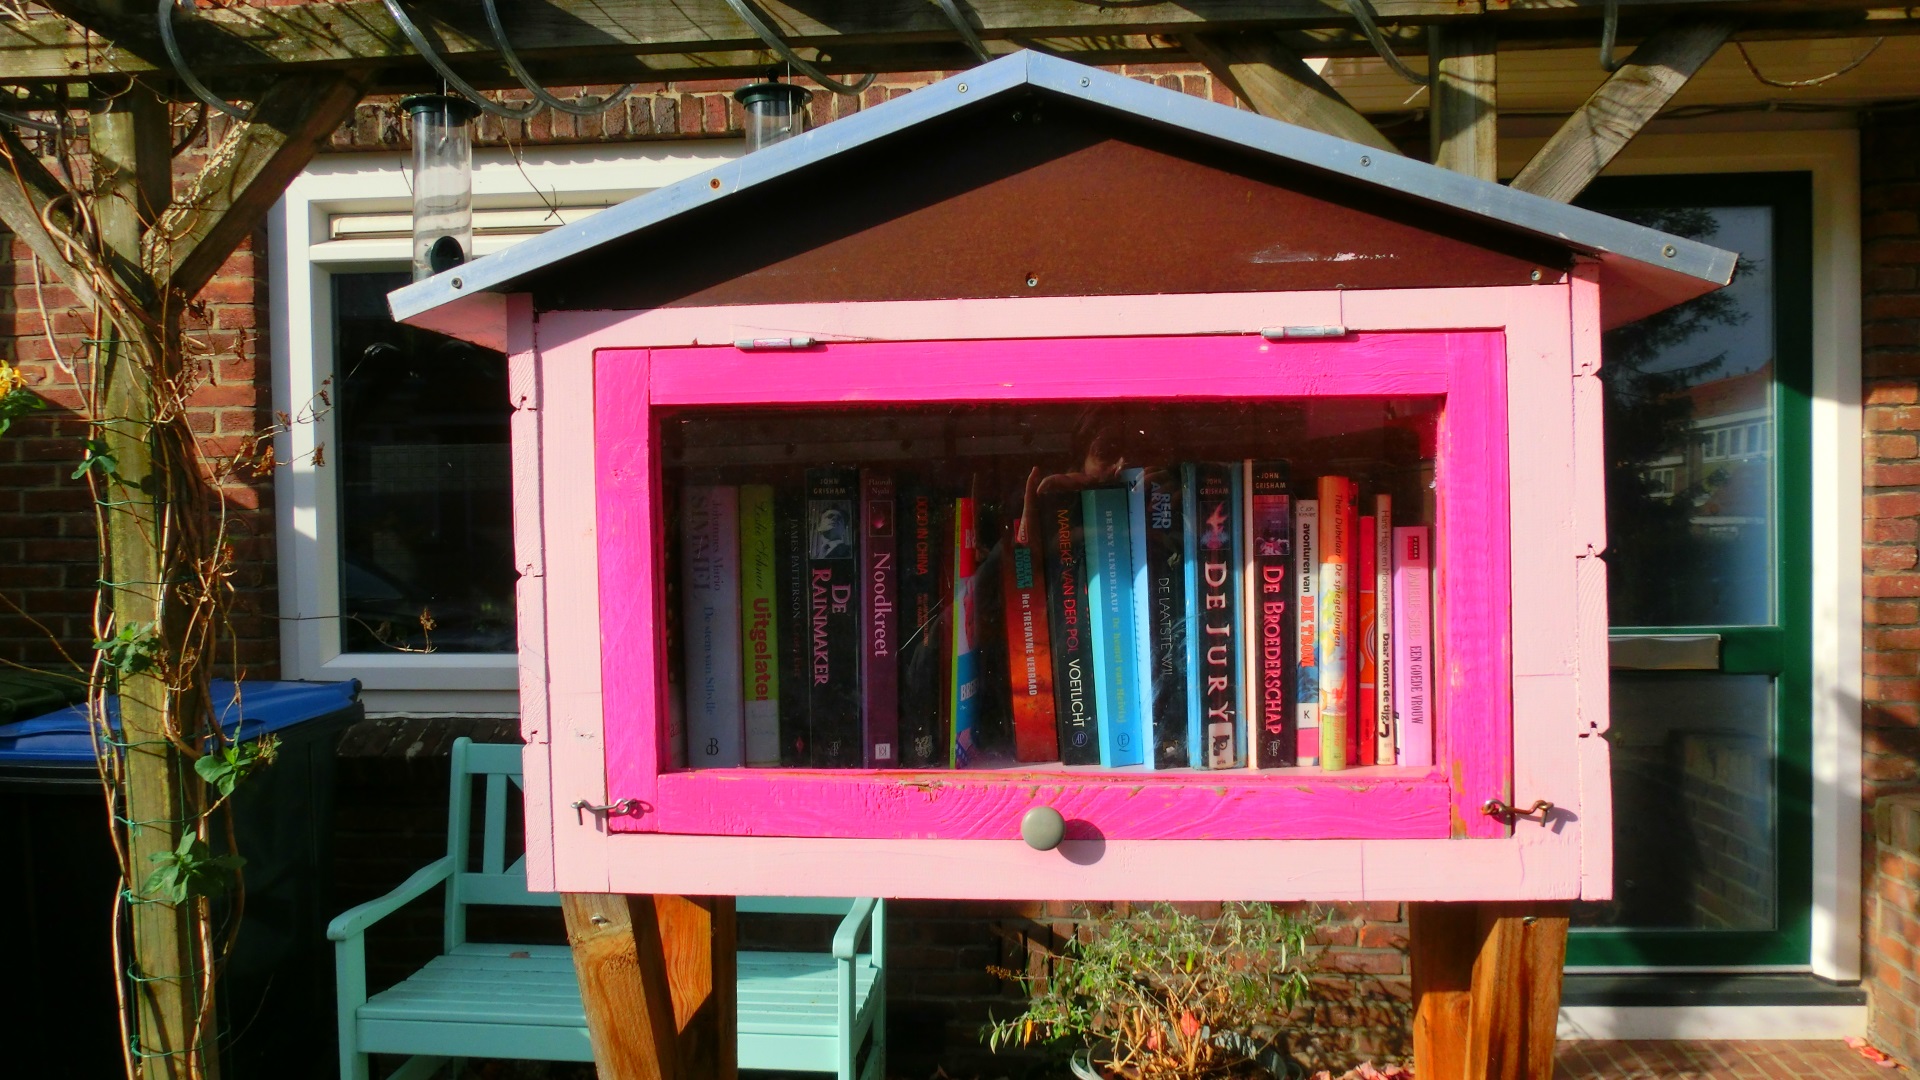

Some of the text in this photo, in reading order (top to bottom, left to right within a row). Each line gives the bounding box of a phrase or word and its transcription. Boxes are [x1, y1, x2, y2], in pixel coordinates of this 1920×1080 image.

[813, 487, 846, 495] GRISHAM
[820, 477, 839, 485] JOHN
[1200, 487, 1231, 495] GRISHAM
[1151, 481, 1162, 530] ARVIN
[1161, 492, 1171, 530] REED
[1381, 509, 1390, 529] Hans
[789, 518, 801, 552] JAMES
[916, 495, 929, 576] DOOD IN CHINA
[1105, 510, 1115, 548] BENNY
[1380, 530, 1391, 556] Hagen
[712, 556, 723, 591] Mario
[1014, 548, 1026, 589] LUDLUM
[1022, 548, 1034, 589] ROBERT
[1333, 493, 1345, 648] Thea Dubelaar De spiegeljongen
[1382, 557, 1389, 567] en
[791, 555, 803, 619] PATTERSON
[1107, 551, 1118, 613] LINDELAUF
[1301, 523, 1315, 668] avonturen van DIK TROM
[1380, 567, 1391, 602] Monique
[874, 551, 893, 658] Noodkreet
[1057, 509, 1085, 728] MARIEKE VAN DER POL VOETLICHT
[1380, 602, 1391, 628] Hagen
[1112, 617, 1121, 631] De
[1158, 577, 1173, 676] DE LAATSTE WIL
[1204, 561, 1230, 722] DE JURY
[1021, 593, 1038, 696] Het TREVAYNE VERRAAD
[1382, 632, 1391, 658] Daar
[1409, 645, 1422, 662] EEN
[1383, 659, 1391, 688] komt
[1410, 664, 1423, 692] GOEDE
[1383, 689, 1392, 702] de
[1411, 694, 1424, 724] VROUW
[1304, 709, 1310, 720] K
